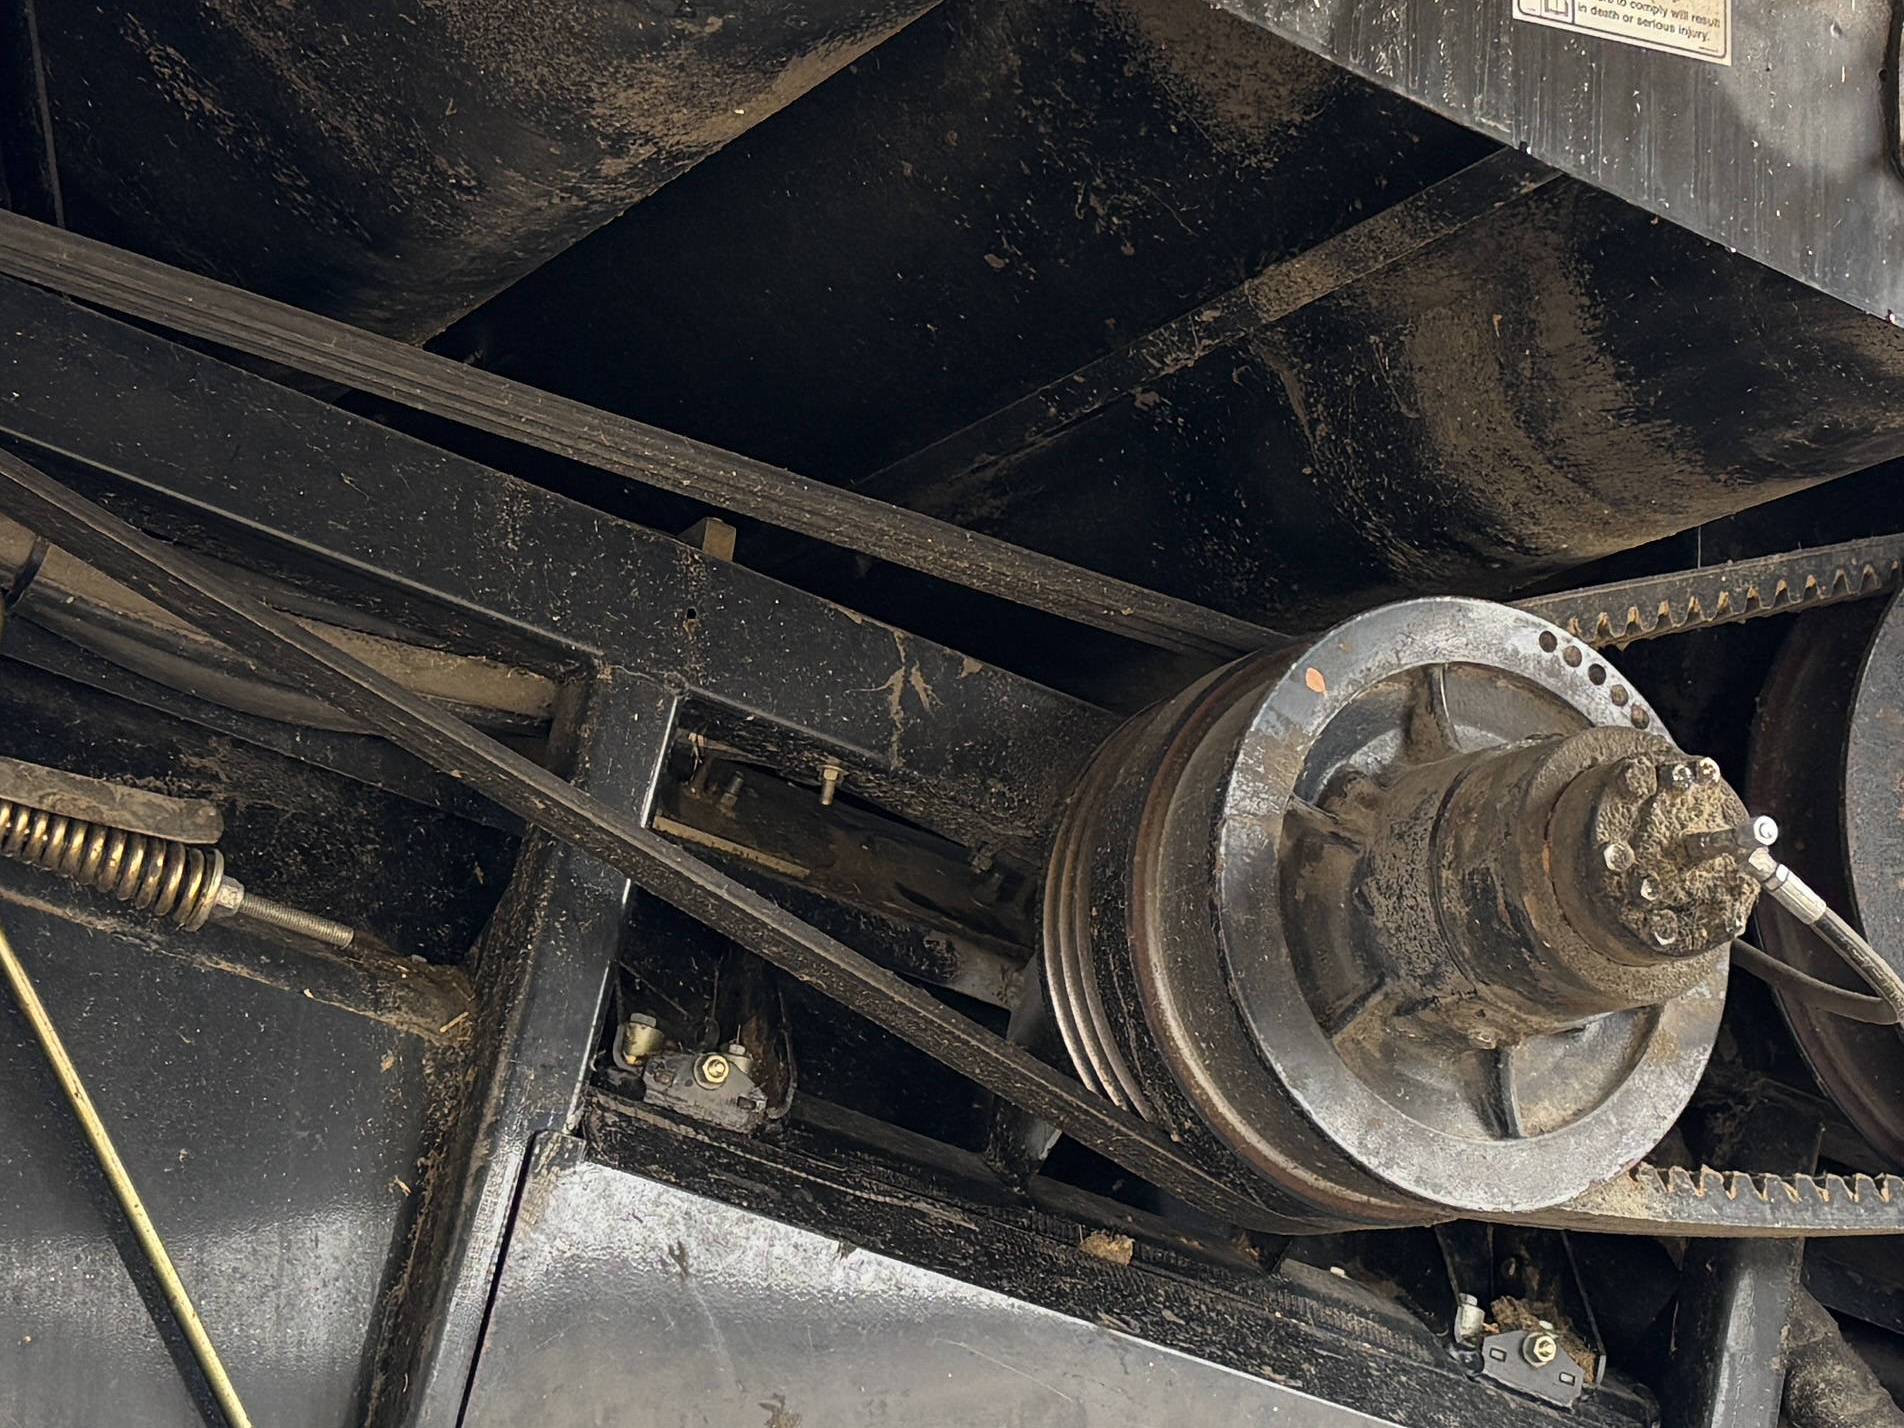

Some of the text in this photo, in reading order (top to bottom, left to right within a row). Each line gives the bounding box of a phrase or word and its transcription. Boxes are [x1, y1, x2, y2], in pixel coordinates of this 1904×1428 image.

[1578, 2, 1710, 42] in death or serious injury.
[1629, 1, 1668, 18] comply
[1671, 9, 1689, 21] will
[1691, 14, 1721, 28] result
